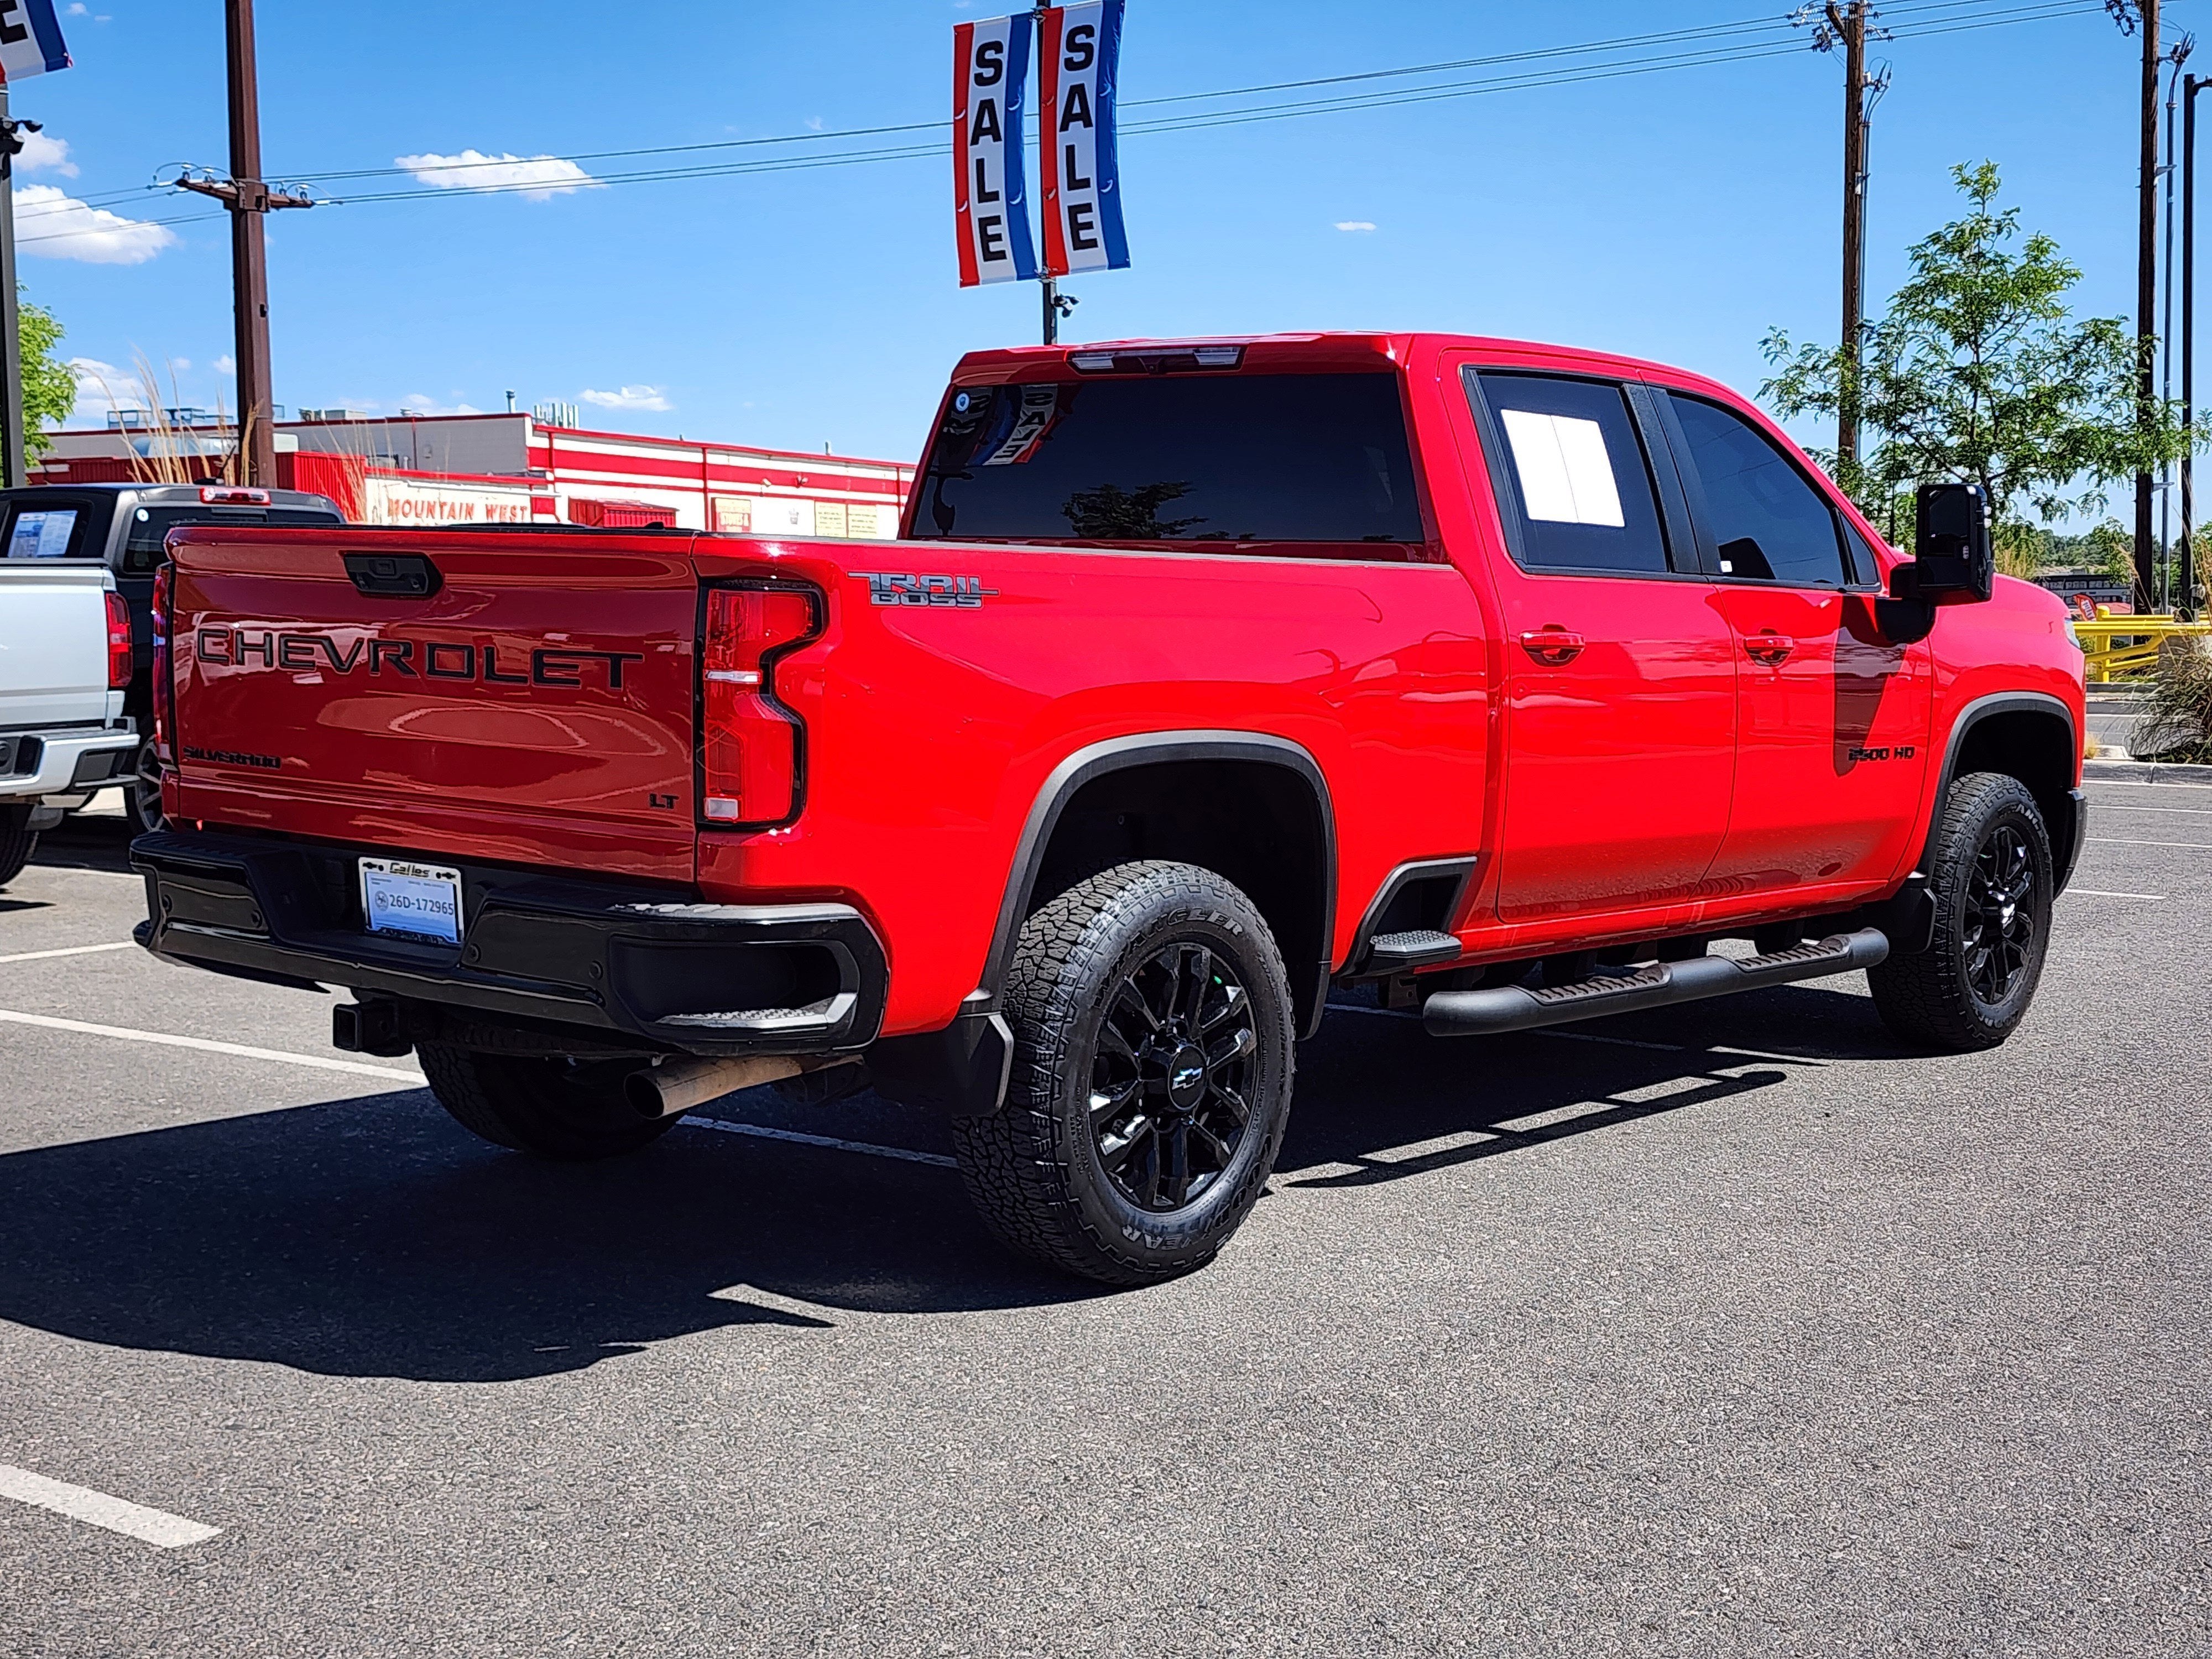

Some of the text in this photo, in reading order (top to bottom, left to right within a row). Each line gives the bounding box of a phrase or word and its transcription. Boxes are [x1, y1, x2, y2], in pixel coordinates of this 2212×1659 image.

[1058, 24, 1098, 251] SALE
[969, 40, 1007, 262] SALE
[388, 499, 527, 521] MOUNTAIN WEST
[847, 571, 999, 595] TRAIL
[870, 592, 982, 608] BOSS
[197, 629, 645, 690] CHEVROLET
[183, 747, 281, 768] SILVERADO
[1849, 746, 1915, 761] 2500 HD
[650, 793, 680, 809] LT
[389, 894, 453, 915] 26D-172965
